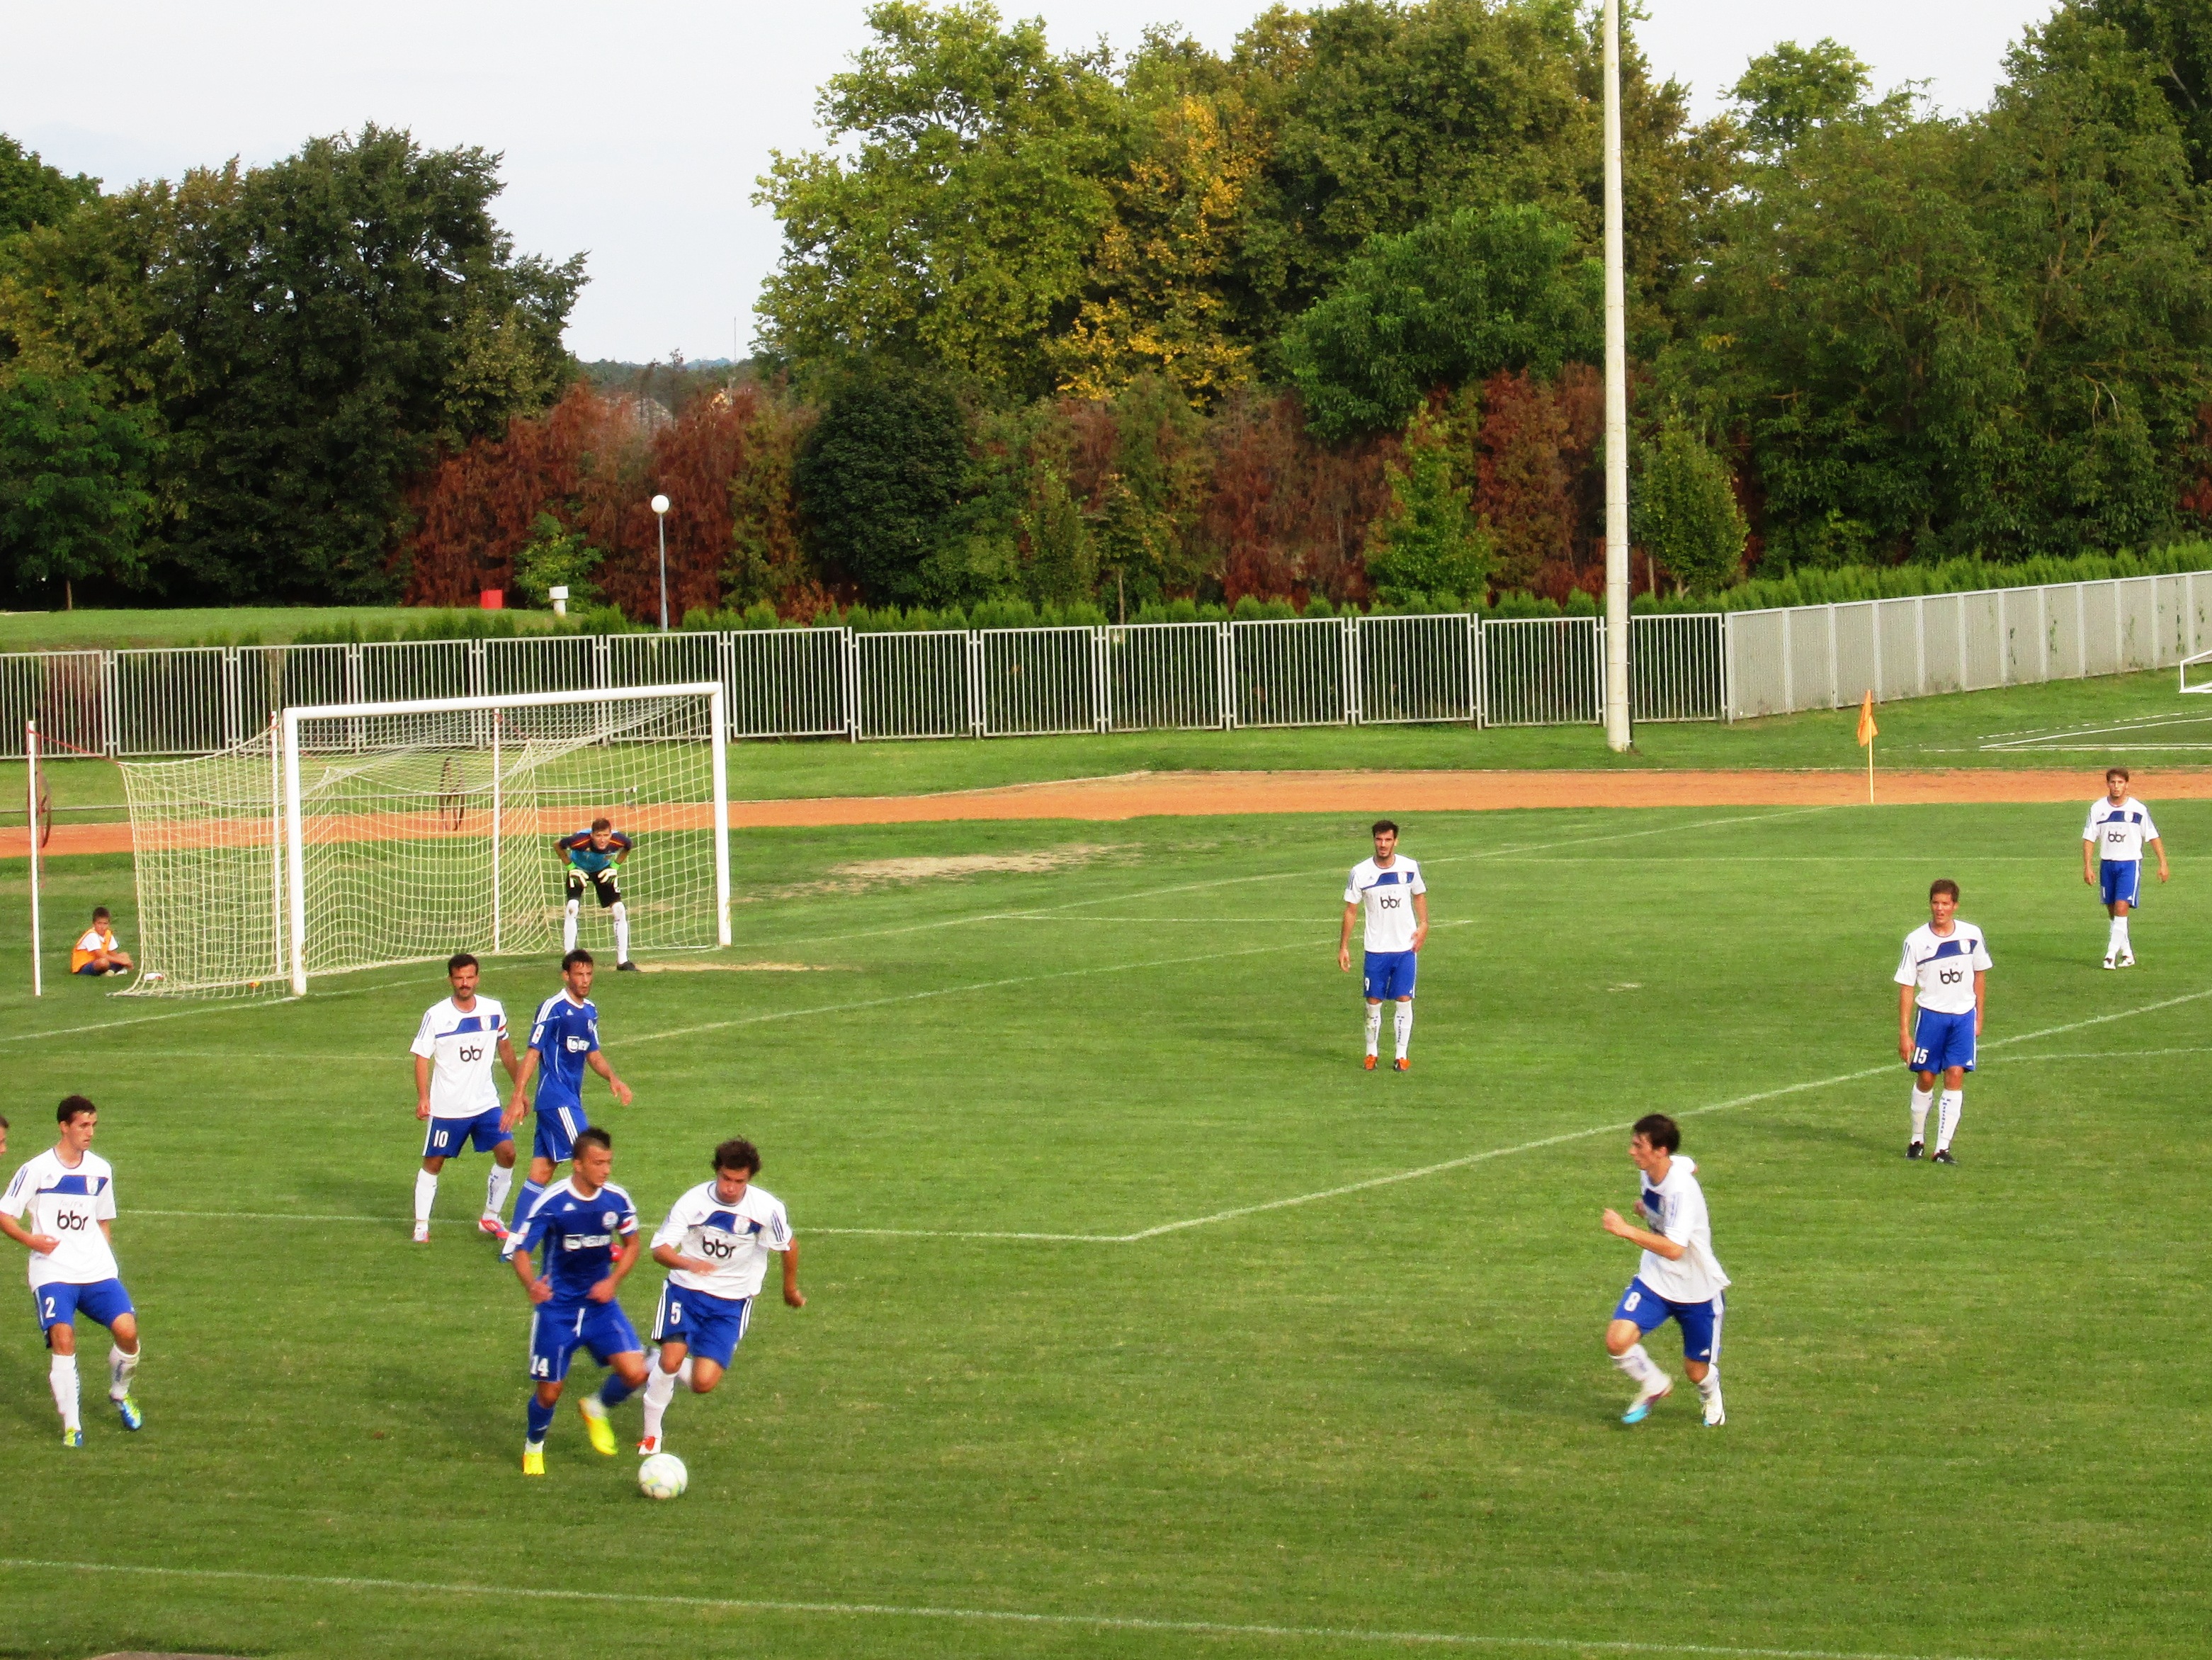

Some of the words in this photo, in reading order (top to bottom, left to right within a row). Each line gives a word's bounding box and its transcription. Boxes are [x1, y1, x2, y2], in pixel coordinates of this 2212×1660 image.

[2108, 831, 2126, 842] bbr
[1380, 896, 1400, 908] bbr
[1940, 969, 1963, 984] bbr
[1913, 1047, 1929, 1064] 15
[433, 1129, 449, 1148] 10
[57, 1209, 88, 1230] bbr
[703, 1236, 736, 1258] bbr
[45, 1297, 55, 1318] 2
[1624, 1292, 1641, 1311] 8
[670, 1302, 681, 1324] 5
[531, 1355, 548, 1377] 14
